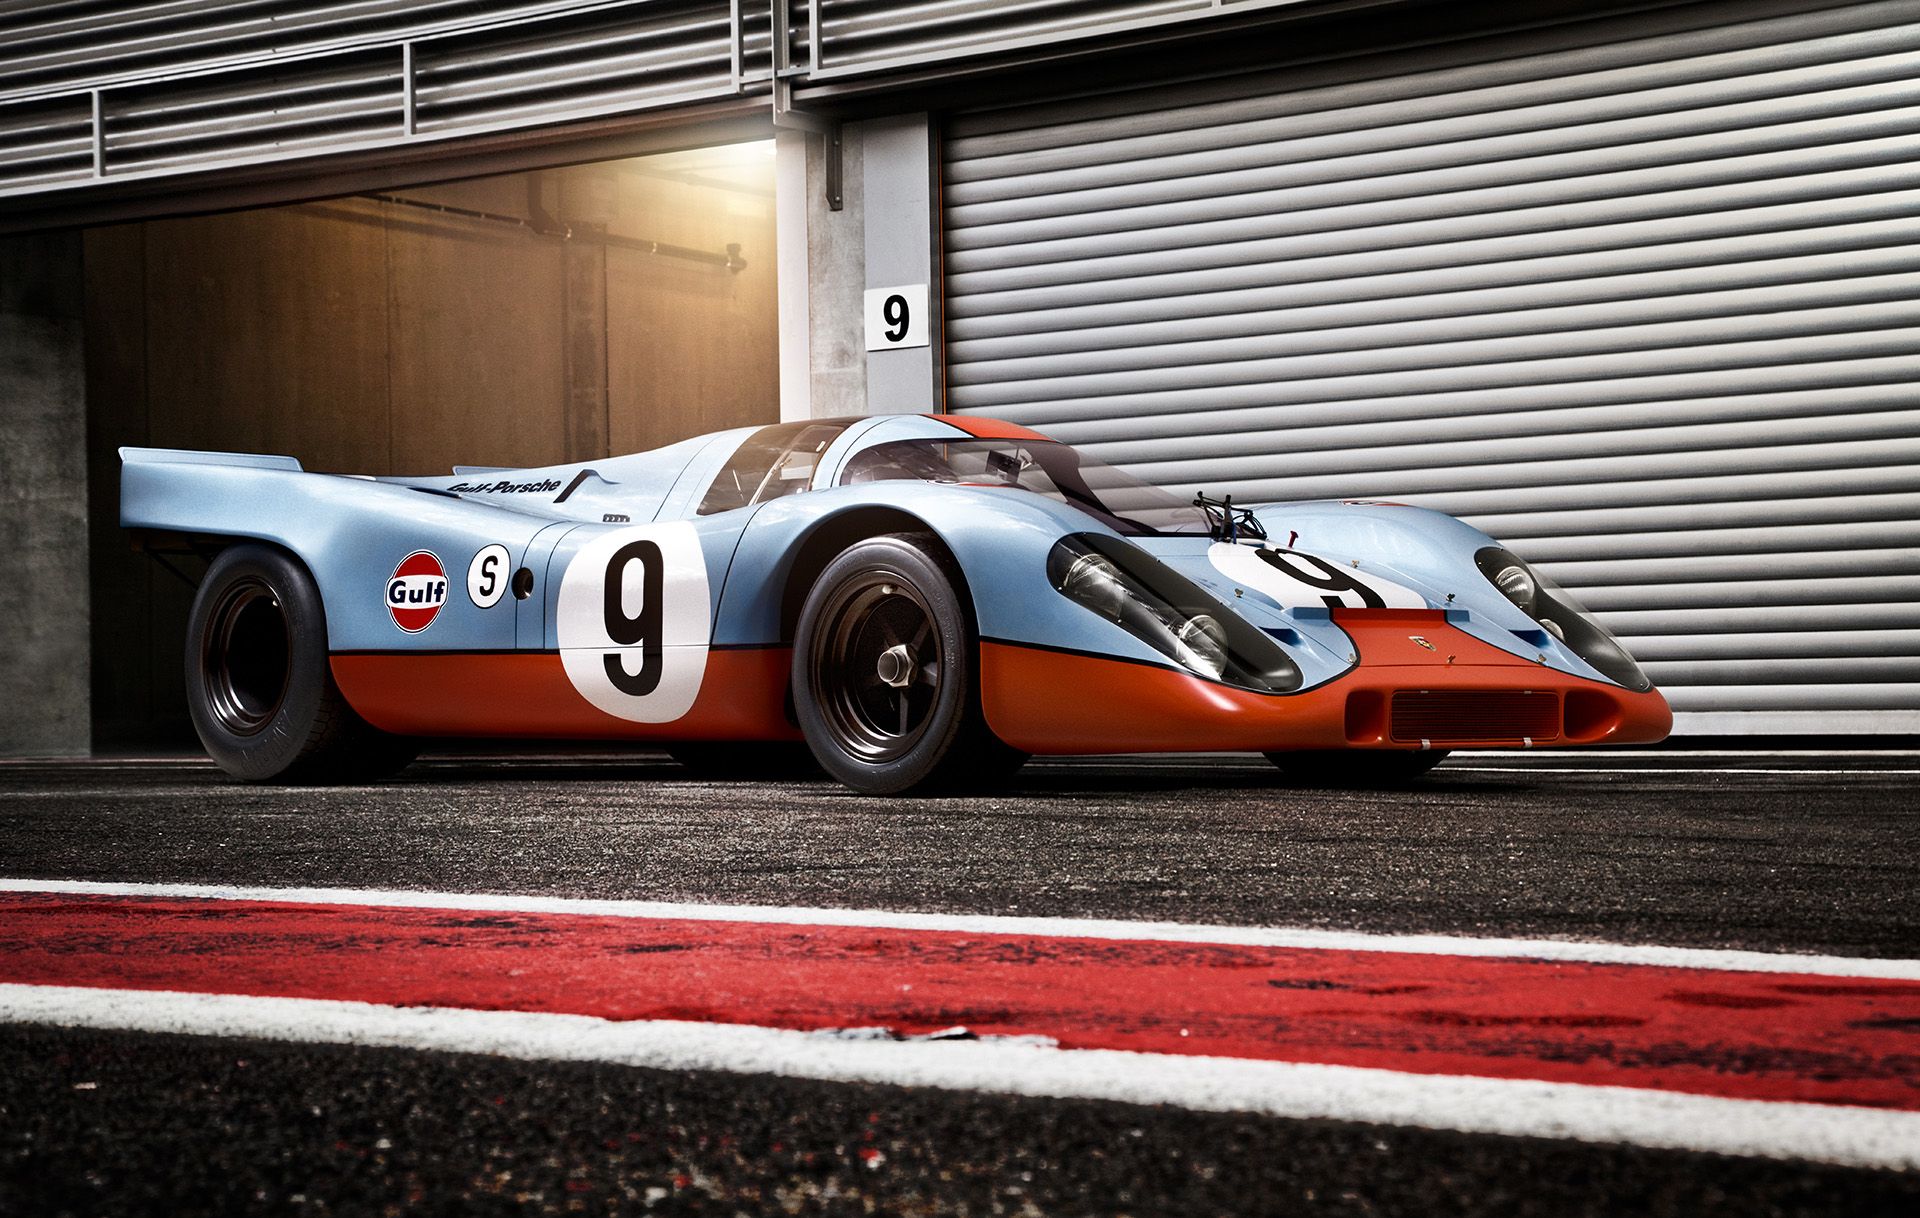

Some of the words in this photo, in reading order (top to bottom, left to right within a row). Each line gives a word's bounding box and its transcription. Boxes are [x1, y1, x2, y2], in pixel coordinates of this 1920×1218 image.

[883, 294, 910, 342] 9
[447, 479, 562, 494] Gulf-Porsche
[388, 580, 446, 604] Gulf
[479, 555, 499, 597] S
[1254, 548, 1387, 609] 9
[603, 540, 664, 697] 9
